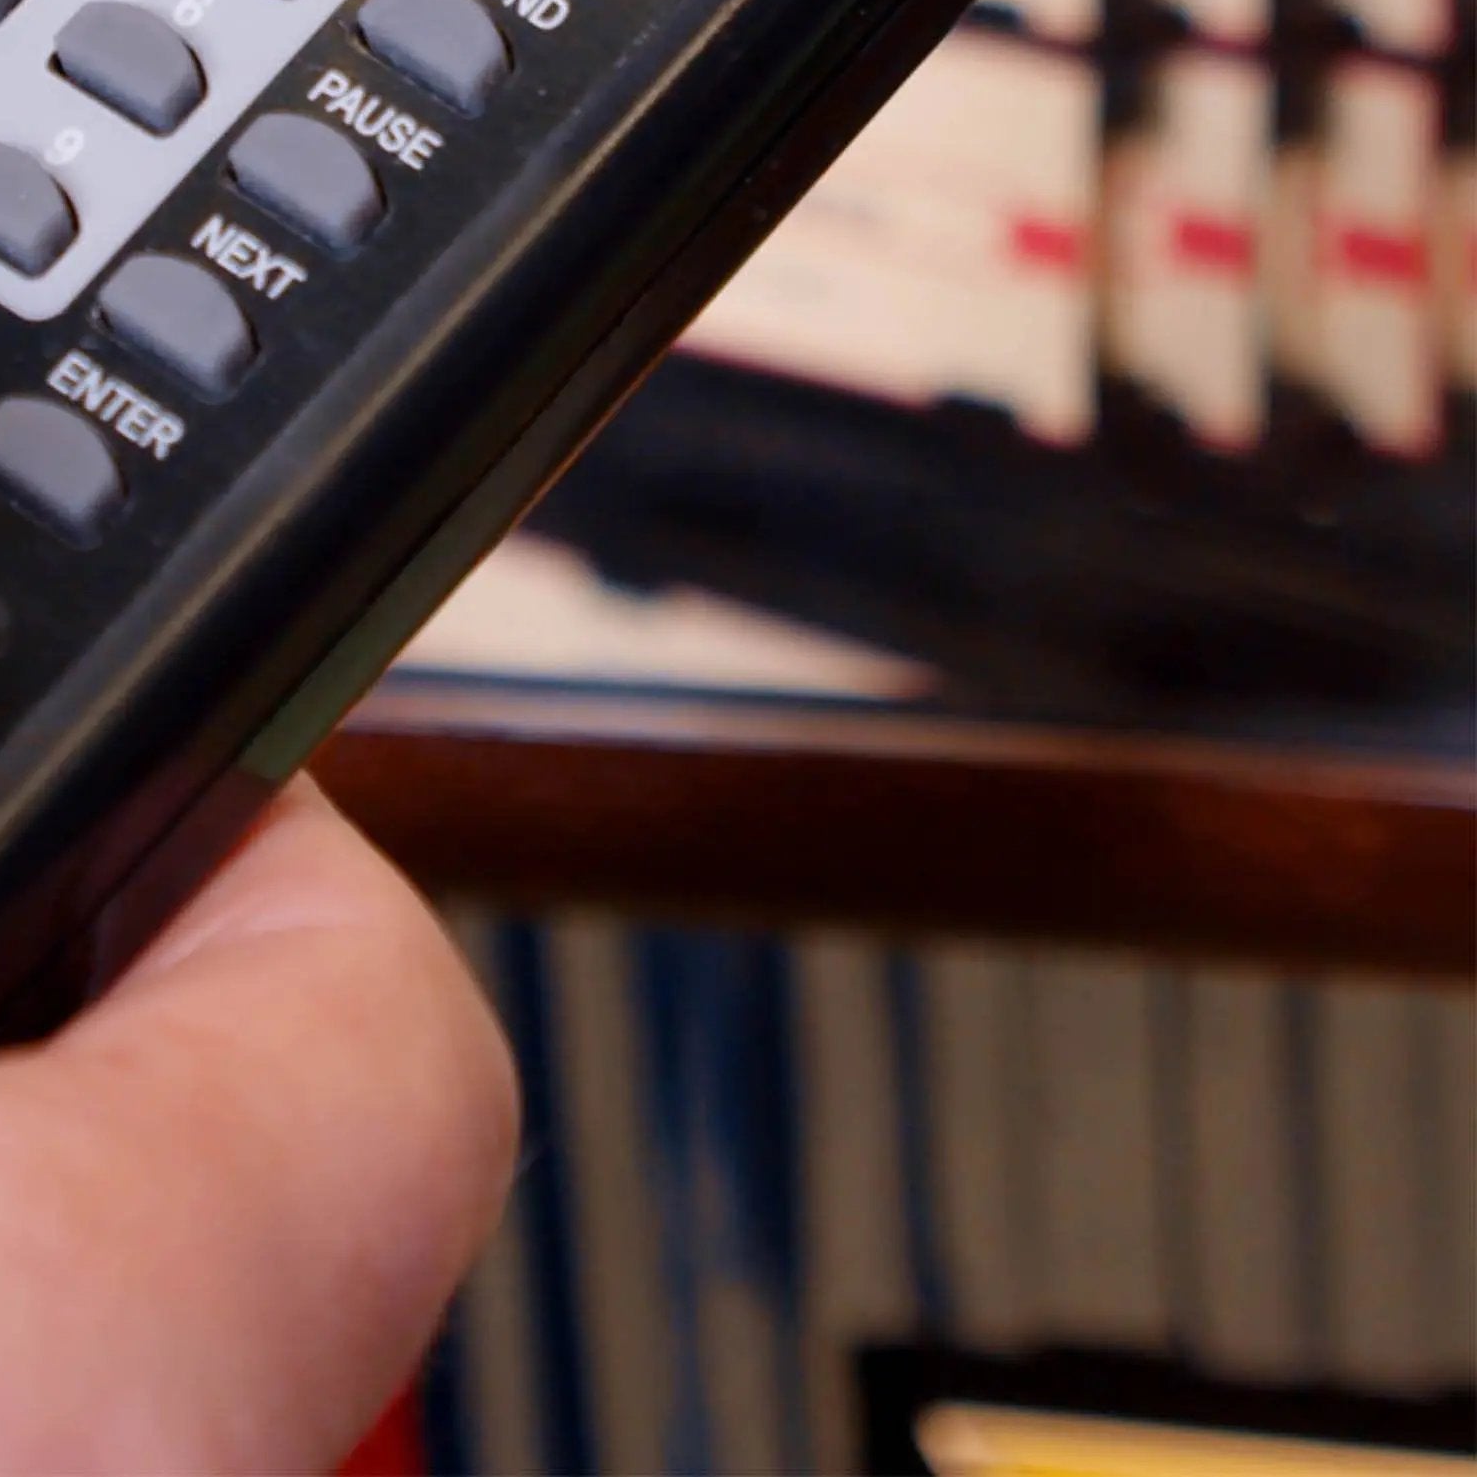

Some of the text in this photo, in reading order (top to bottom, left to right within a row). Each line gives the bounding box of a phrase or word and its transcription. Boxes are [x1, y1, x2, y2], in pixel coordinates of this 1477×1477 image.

[43, 127, 86, 166] 9
[306, 68, 445, 171] PAUSE
[190, 214, 308, 300] NEXT
[45, 347, 186, 461] ENTER
